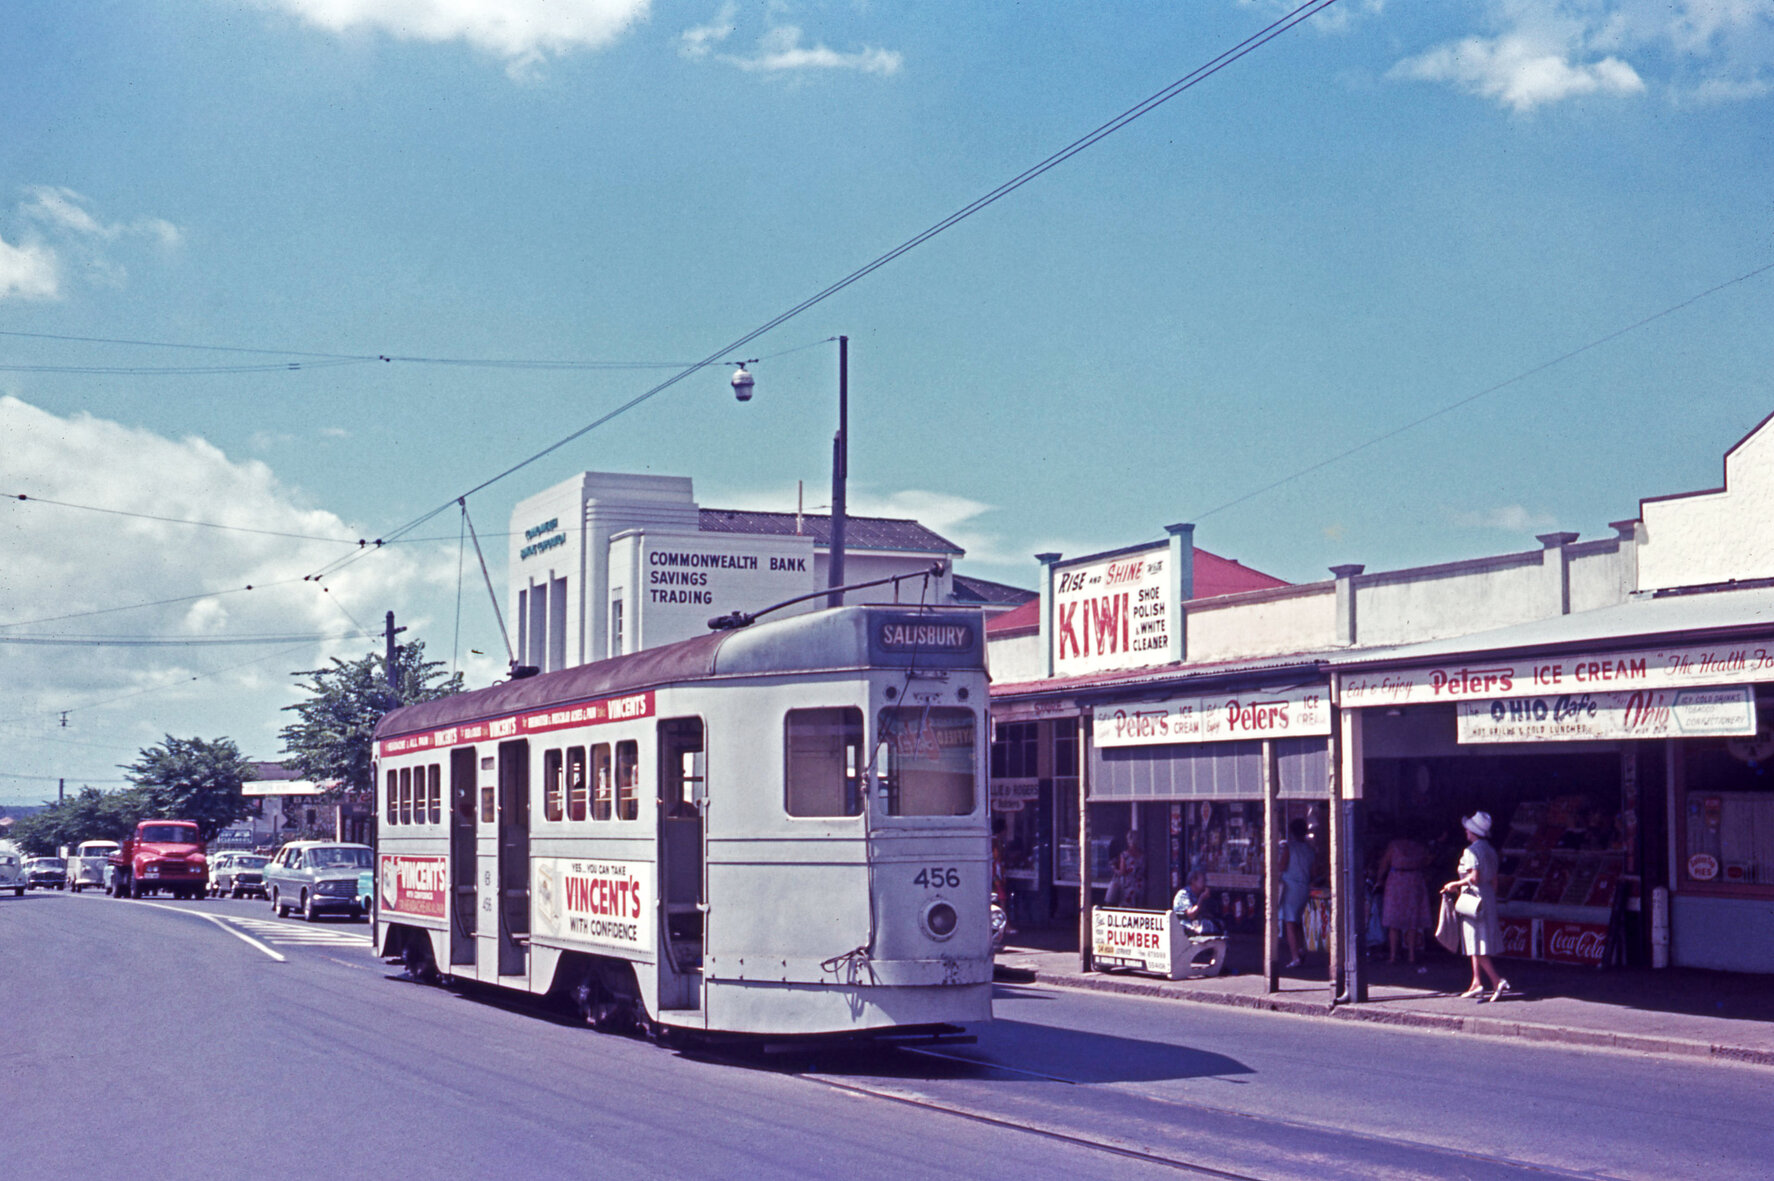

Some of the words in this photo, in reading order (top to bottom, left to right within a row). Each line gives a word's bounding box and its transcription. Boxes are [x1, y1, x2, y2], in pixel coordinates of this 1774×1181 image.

[650, 551, 758, 570] COMMONWEALTH
[769, 557, 806, 572] BANK
[650, 571, 708, 586] SAVINGS
[1058, 572, 1087, 593] RISE
[1107, 561, 1144, 585] SHINE
[650, 589, 713, 604] TRADING
[1138, 586, 1160, 602] SHOE
[1133, 602, 1165, 618] POLISH
[884, 624, 967, 646] SALISBURY
[1059, 592, 1129, 660] KIWI
[1140, 619, 1166, 634] WHITE
[1133, 635, 1169, 651] CLEANER
[1347, 679, 1366, 698] Eat
[1428, 668, 1514, 695] Peters
[1533, 664, 1562, 685] ICE
[1575, 658, 1647, 682] CREAM
[1700, 650, 1746, 673] Health
[1113, 709, 1169, 738] Peters
[1179, 706, 1193, 719] ICE
[1225, 699, 1289, 731] Peters
[1303, 695, 1319, 709] ICE
[1490, 700, 1548, 721] OHIO
[1174, 720, 1199, 735] CREAM
[611, 866, 626, 876] TAKE
[913, 867, 960, 889] 456
[565, 875, 641, 919] VINCENT'S
[570, 916, 589, 934] WITH
[590, 918, 638, 942] CONFIDENCE
[1107, 930, 1160, 949] PLUMBER
